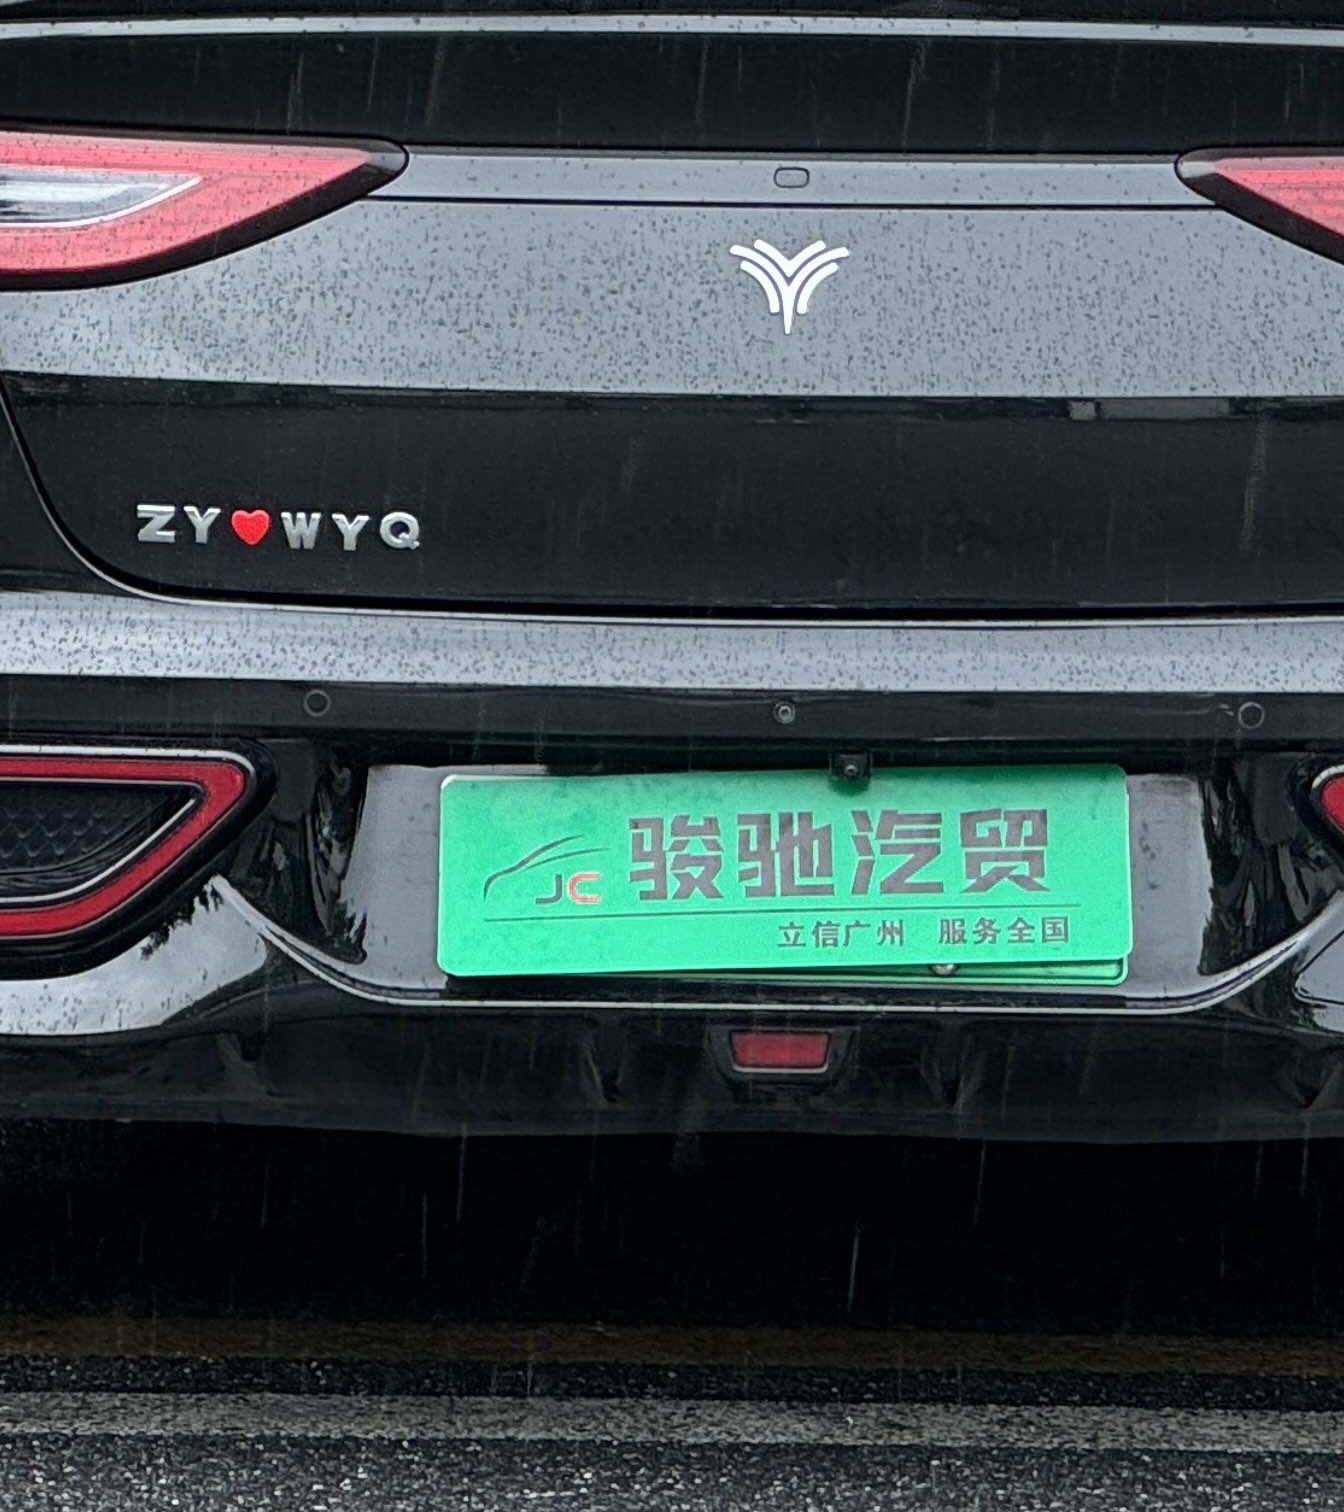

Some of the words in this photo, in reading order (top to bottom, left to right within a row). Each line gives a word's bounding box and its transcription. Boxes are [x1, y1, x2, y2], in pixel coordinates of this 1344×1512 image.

[628, 808, 1051, 901] 骏驰汽贸
[534, 870, 602, 905] JC
[776, 918, 906, 950] 立信广州
[936, 914, 1071, 946] 服务全国
